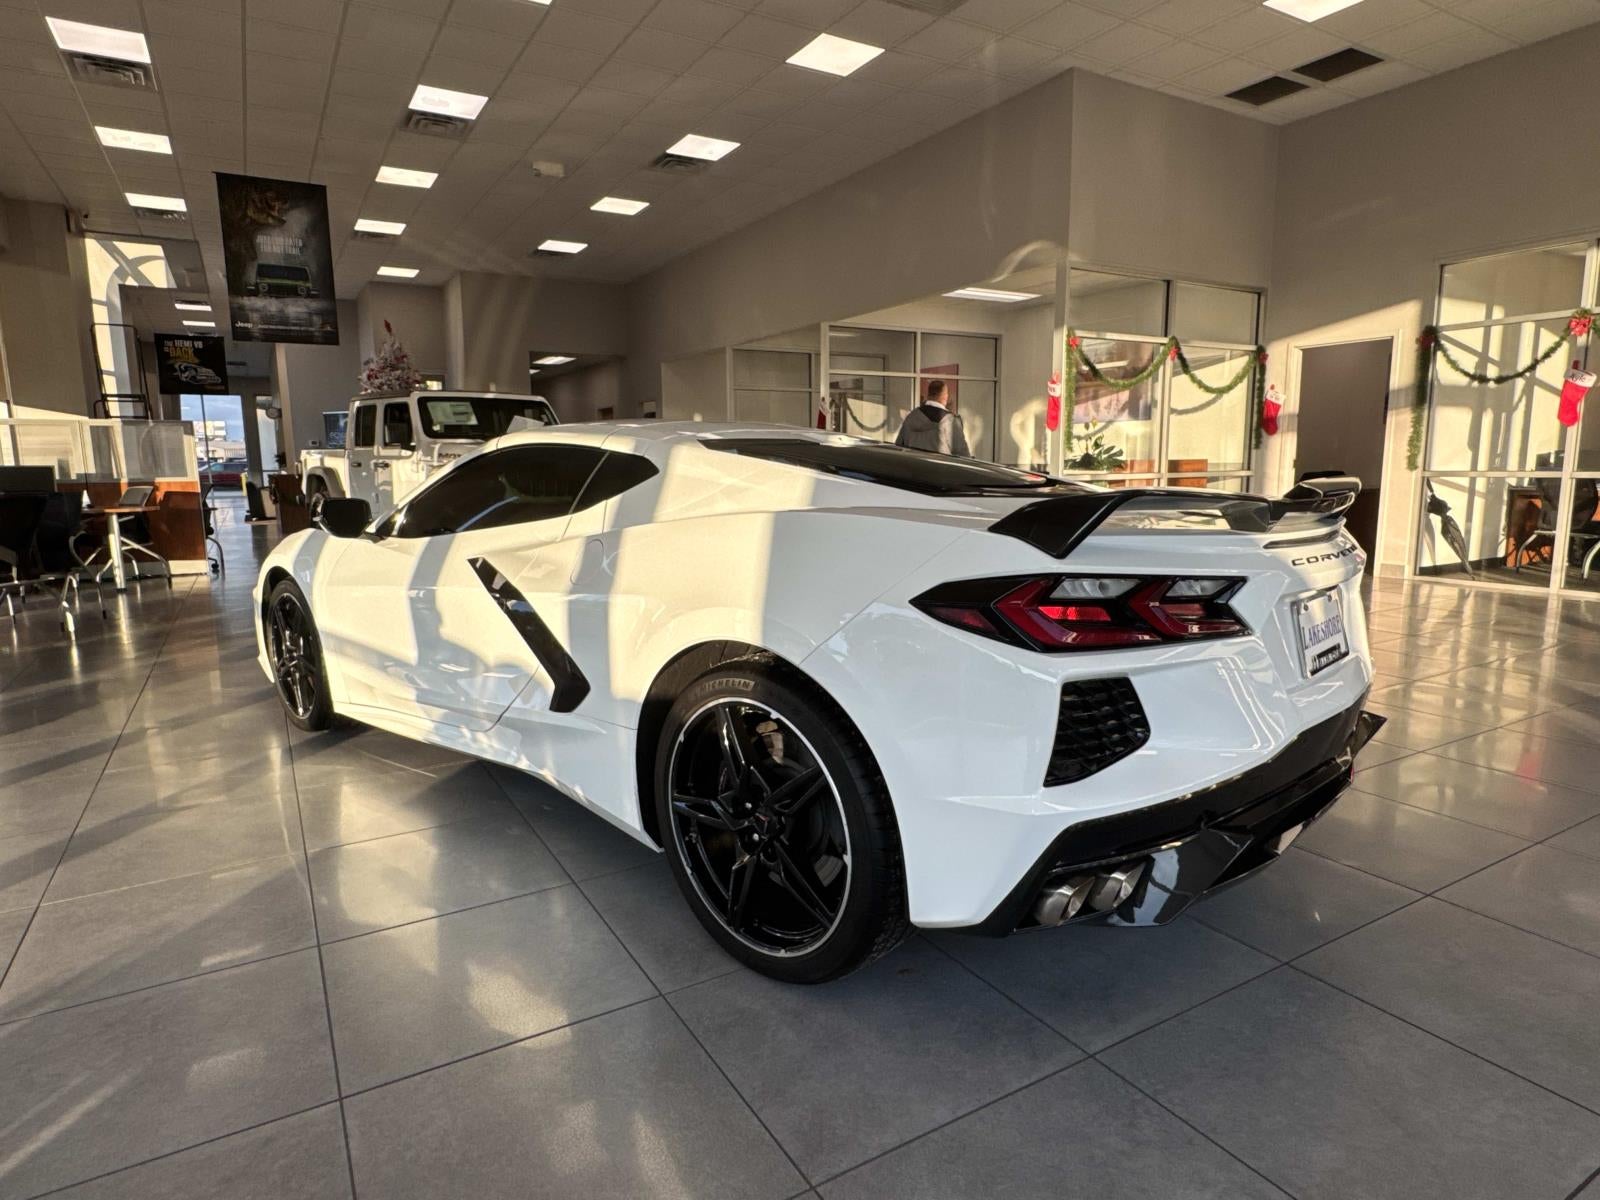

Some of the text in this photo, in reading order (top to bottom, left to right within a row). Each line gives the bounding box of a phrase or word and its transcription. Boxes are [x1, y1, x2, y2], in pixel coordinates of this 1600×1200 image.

[235, 320, 253, 328] Jeep
[169, 347, 194, 361] BACK
[1302, 615, 1341, 649] LAKESHORE
[699, 678, 752, 693] MICHELIN
